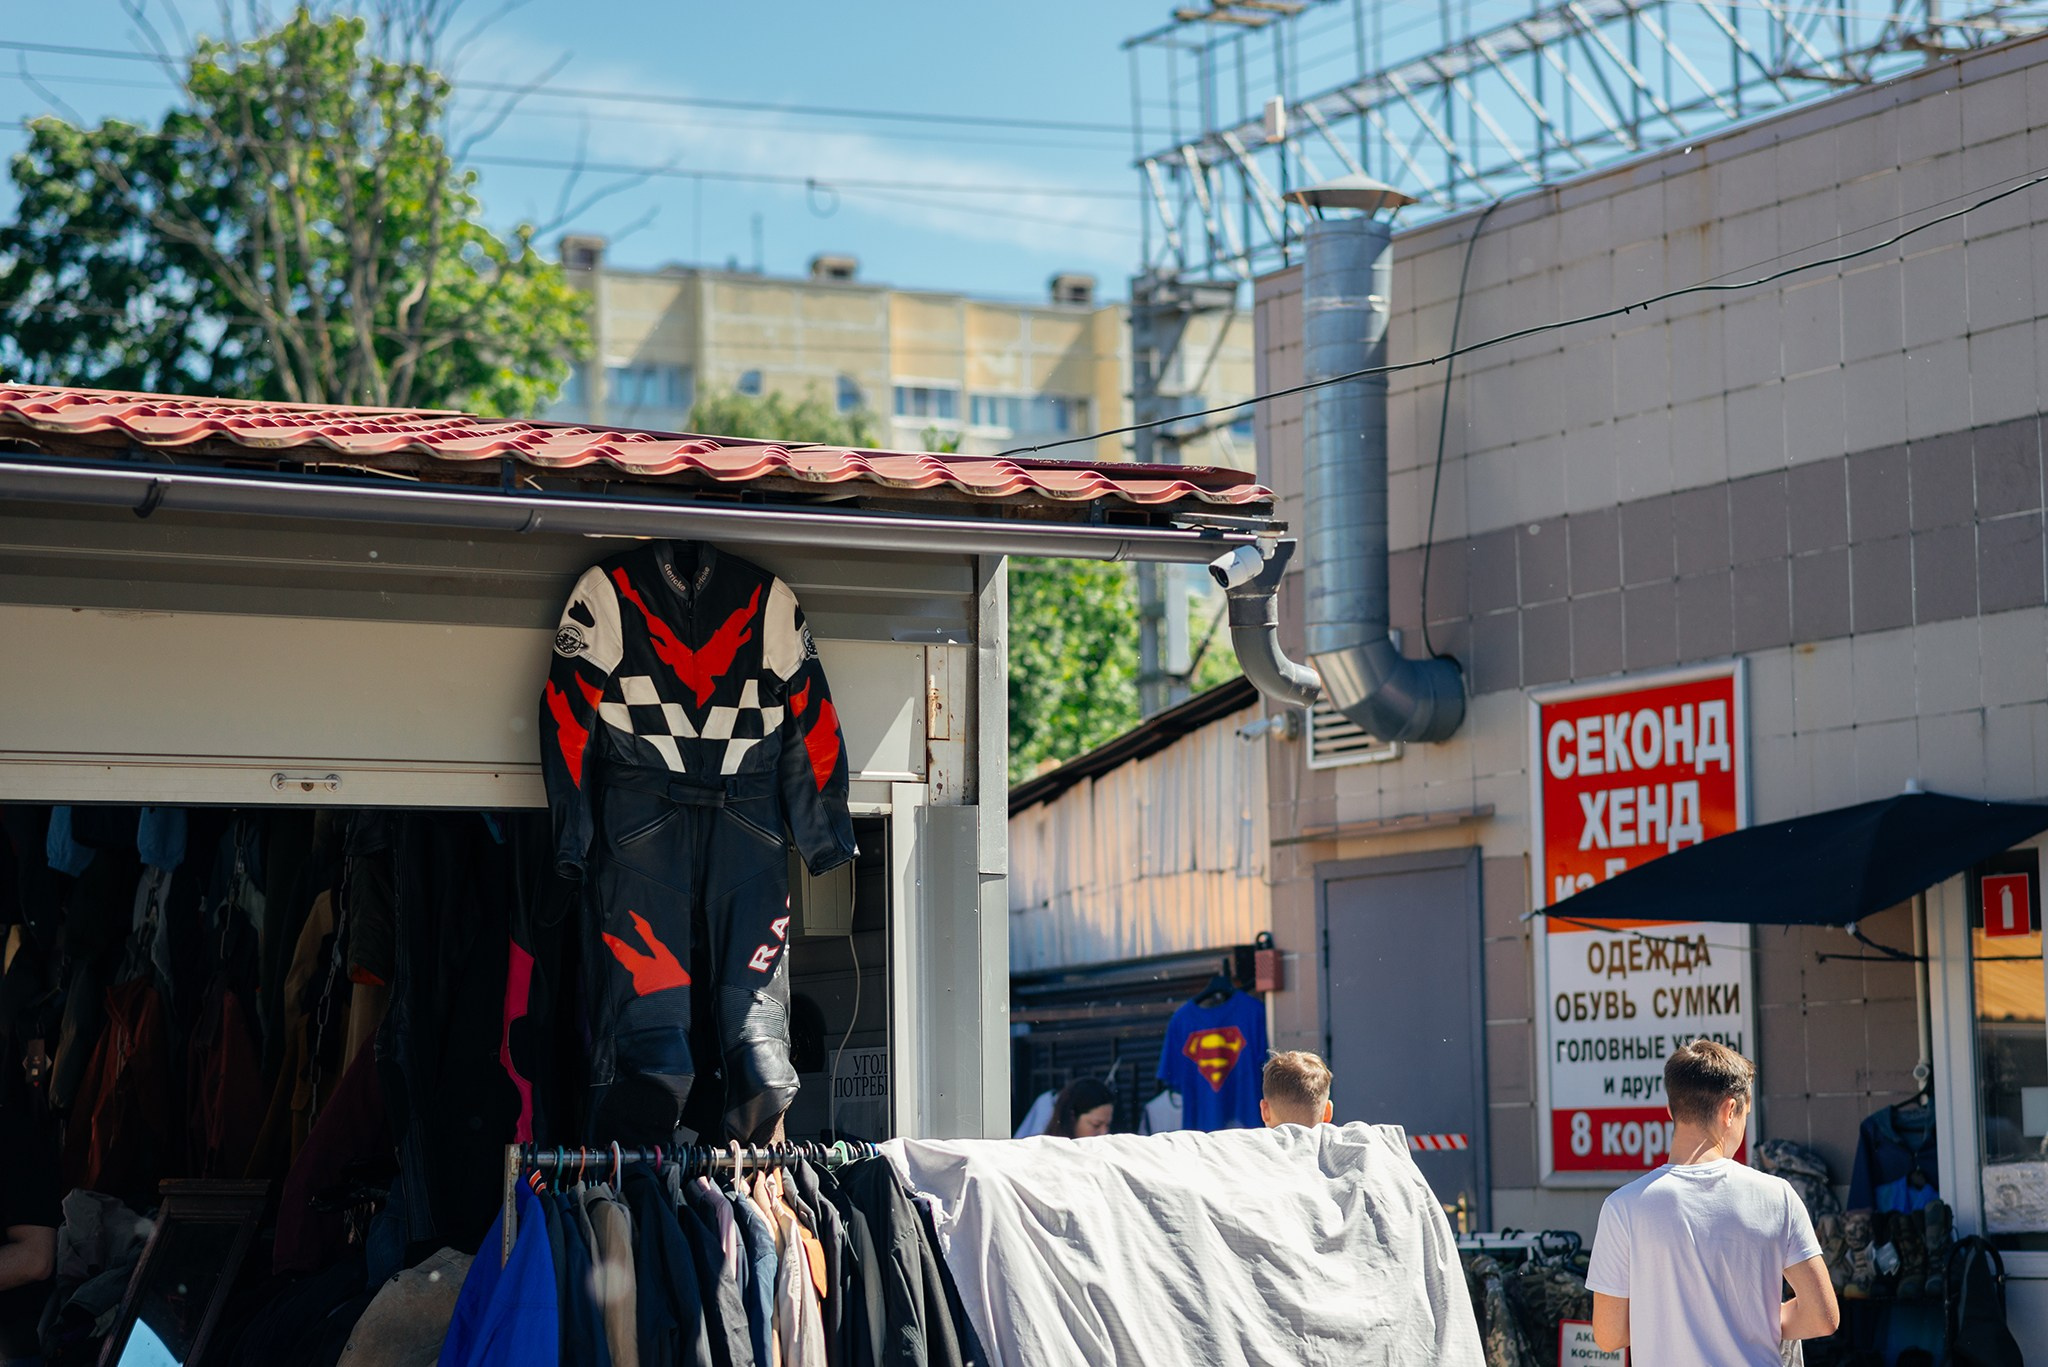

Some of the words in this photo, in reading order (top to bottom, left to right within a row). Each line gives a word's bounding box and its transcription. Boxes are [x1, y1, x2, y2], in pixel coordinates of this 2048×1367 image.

[664, 563, 686, 592] Gericke
[1547, 699, 1730, 780] СЕКОНД
[1578, 780, 1703, 854] ХЕНД
[747, 892, 791, 974] RA
[1588, 934, 1711, 980] ОДЕЖДА
[1555, 990, 1636, 1022] ОБУВЬ
[1652, 983, 1740, 1018] СУМКИ
[1556, 1035, 1666, 1062] ГОЛОВНЫЕ
[1604, 1076, 1614, 1093] и
[1621, 1074, 1662, 1099] друг
[1571, 1111, 1592, 1157] 8
[1570, 1348, 1620, 1361] КОСТЮМ
